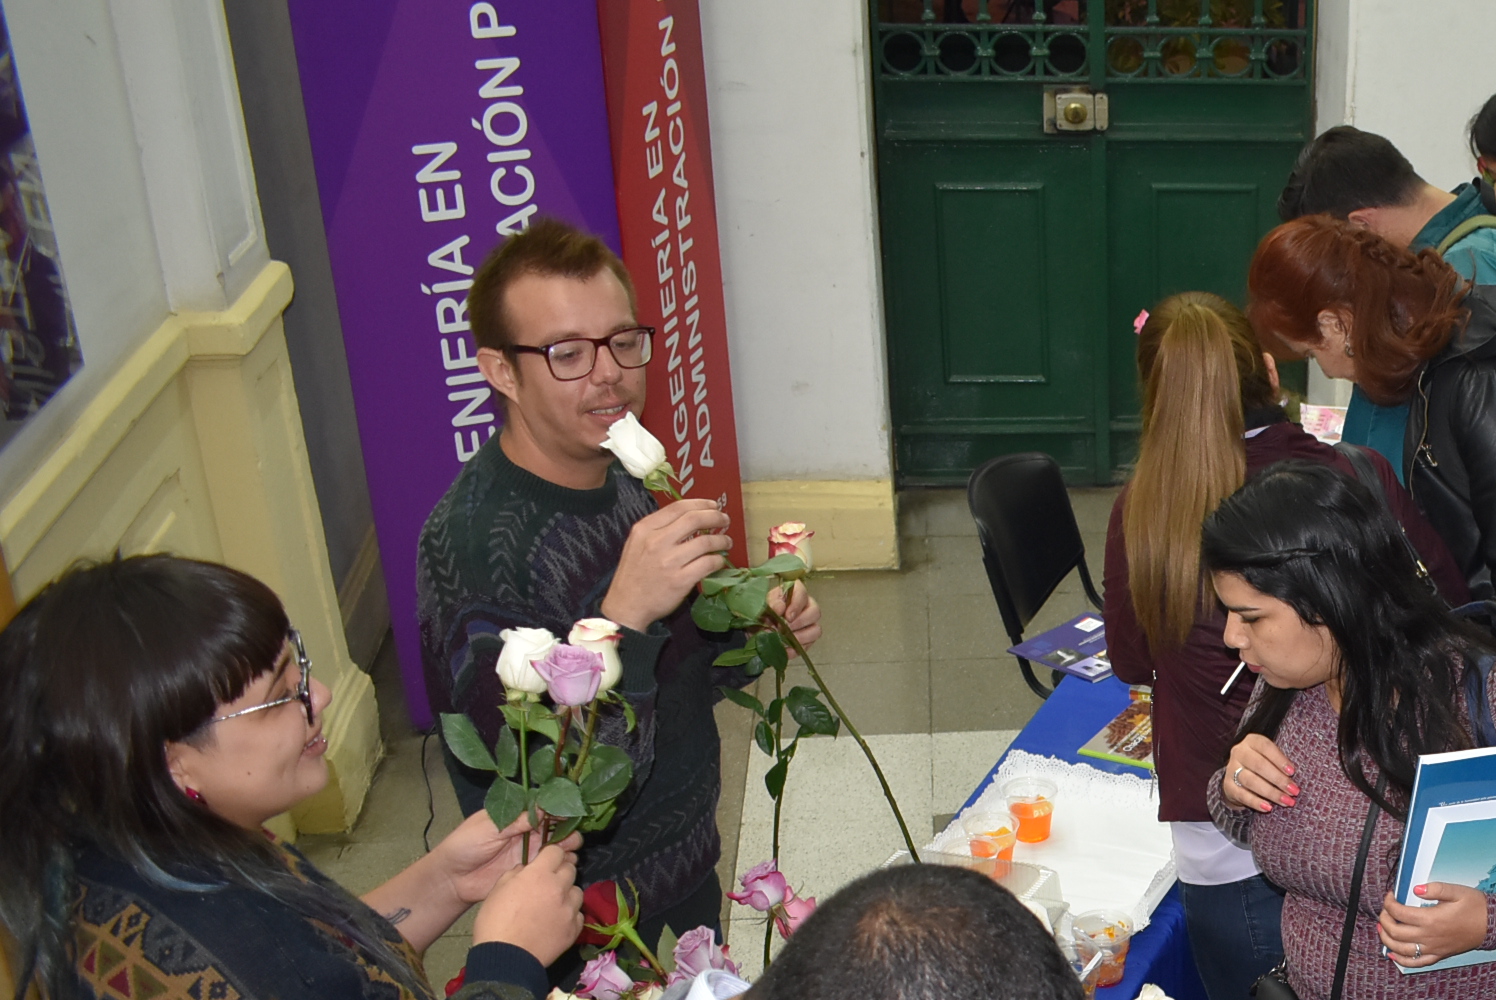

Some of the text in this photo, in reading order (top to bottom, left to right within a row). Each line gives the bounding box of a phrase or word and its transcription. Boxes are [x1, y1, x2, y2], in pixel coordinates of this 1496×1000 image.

[411, 141, 466, 223] EN
[642, 100, 694, 496] INGENIERÍA EN
[657, 15, 716, 468] ADMINISTRACIÓN
